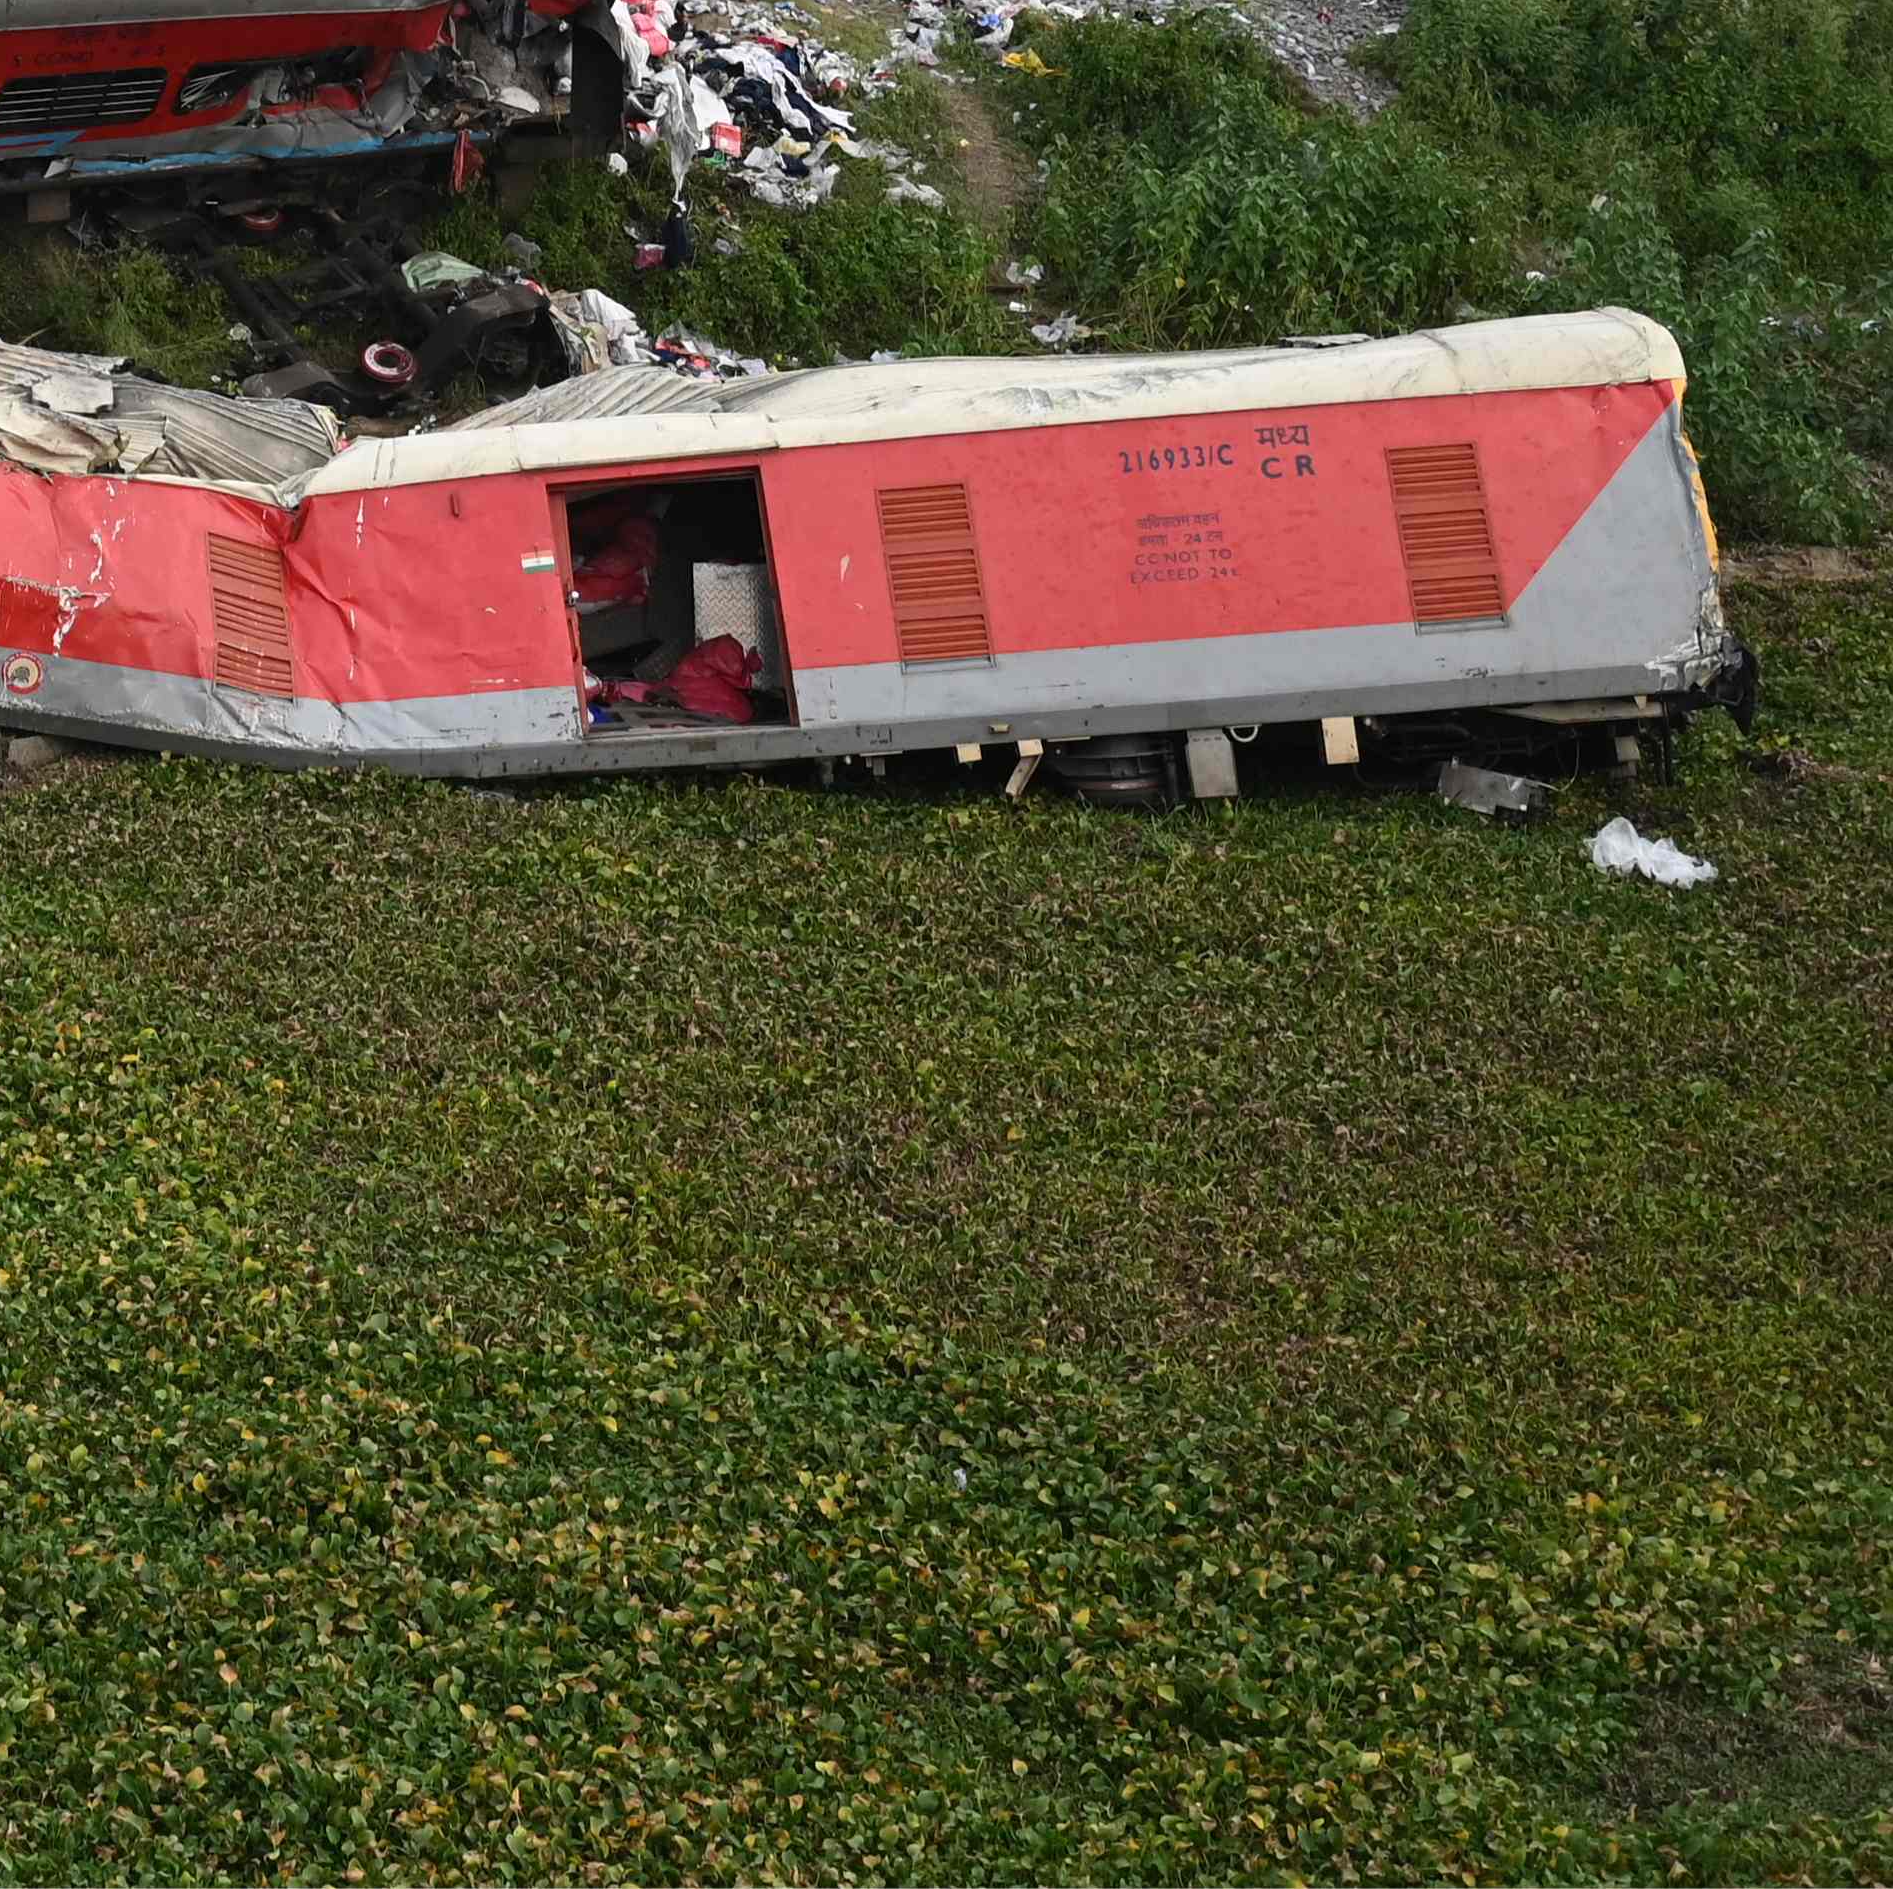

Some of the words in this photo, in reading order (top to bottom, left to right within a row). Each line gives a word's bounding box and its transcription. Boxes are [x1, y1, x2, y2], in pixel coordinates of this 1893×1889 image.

[1254, 424, 1310, 450] मध्य
[1183, 532, 1202, 545] 24
[1163, 550, 1200, 564] NOT
[1208, 548, 1233, 561] TO
[1130, 567, 1199, 584] EXCEED
